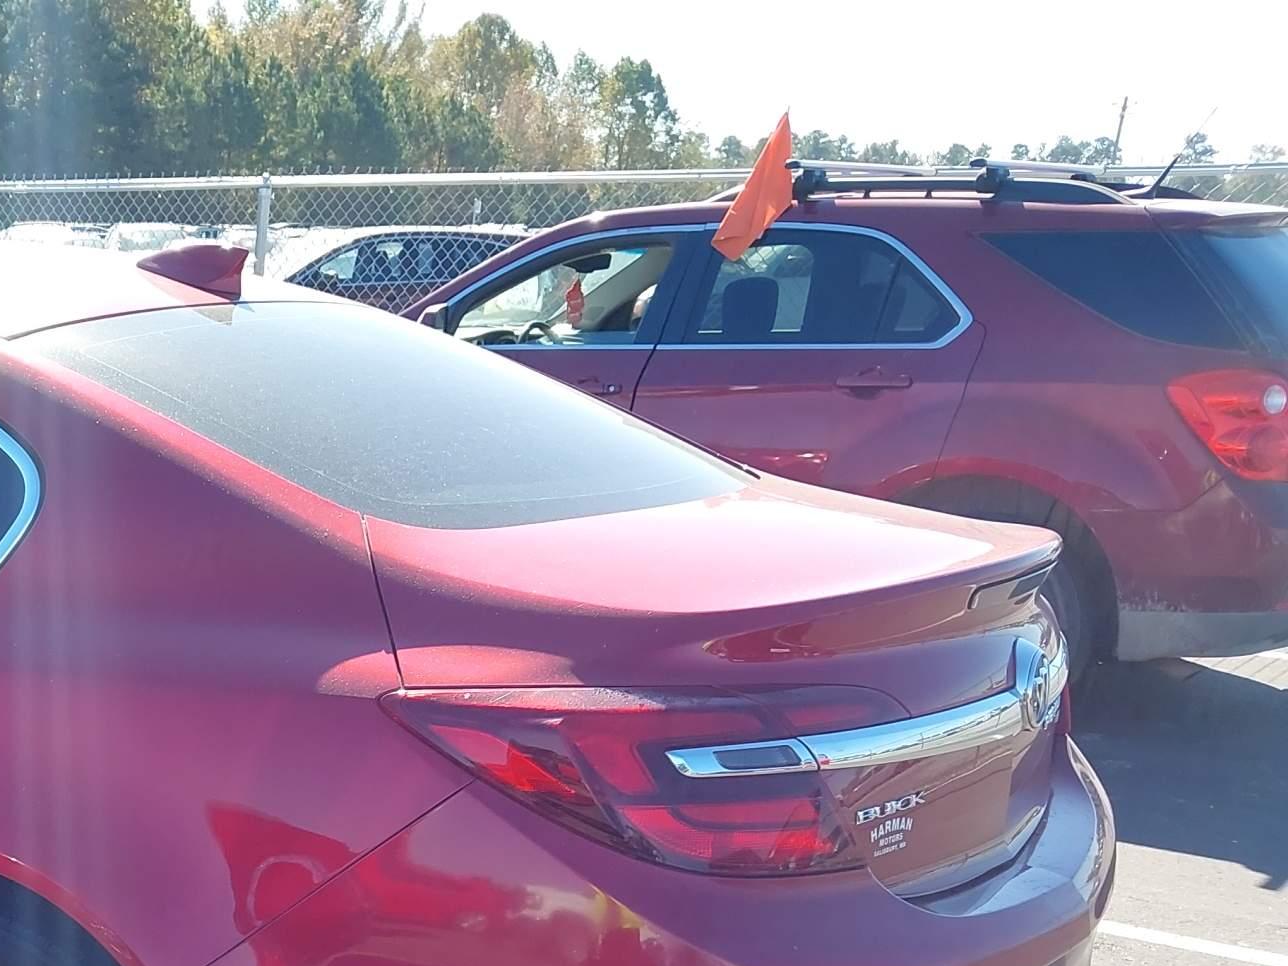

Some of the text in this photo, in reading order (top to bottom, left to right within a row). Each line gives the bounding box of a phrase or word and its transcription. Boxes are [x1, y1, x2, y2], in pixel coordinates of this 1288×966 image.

[856, 791, 926, 825] BUICK
[870, 817, 913, 843] HARMAN
[879, 832, 904, 847] MOTORS
